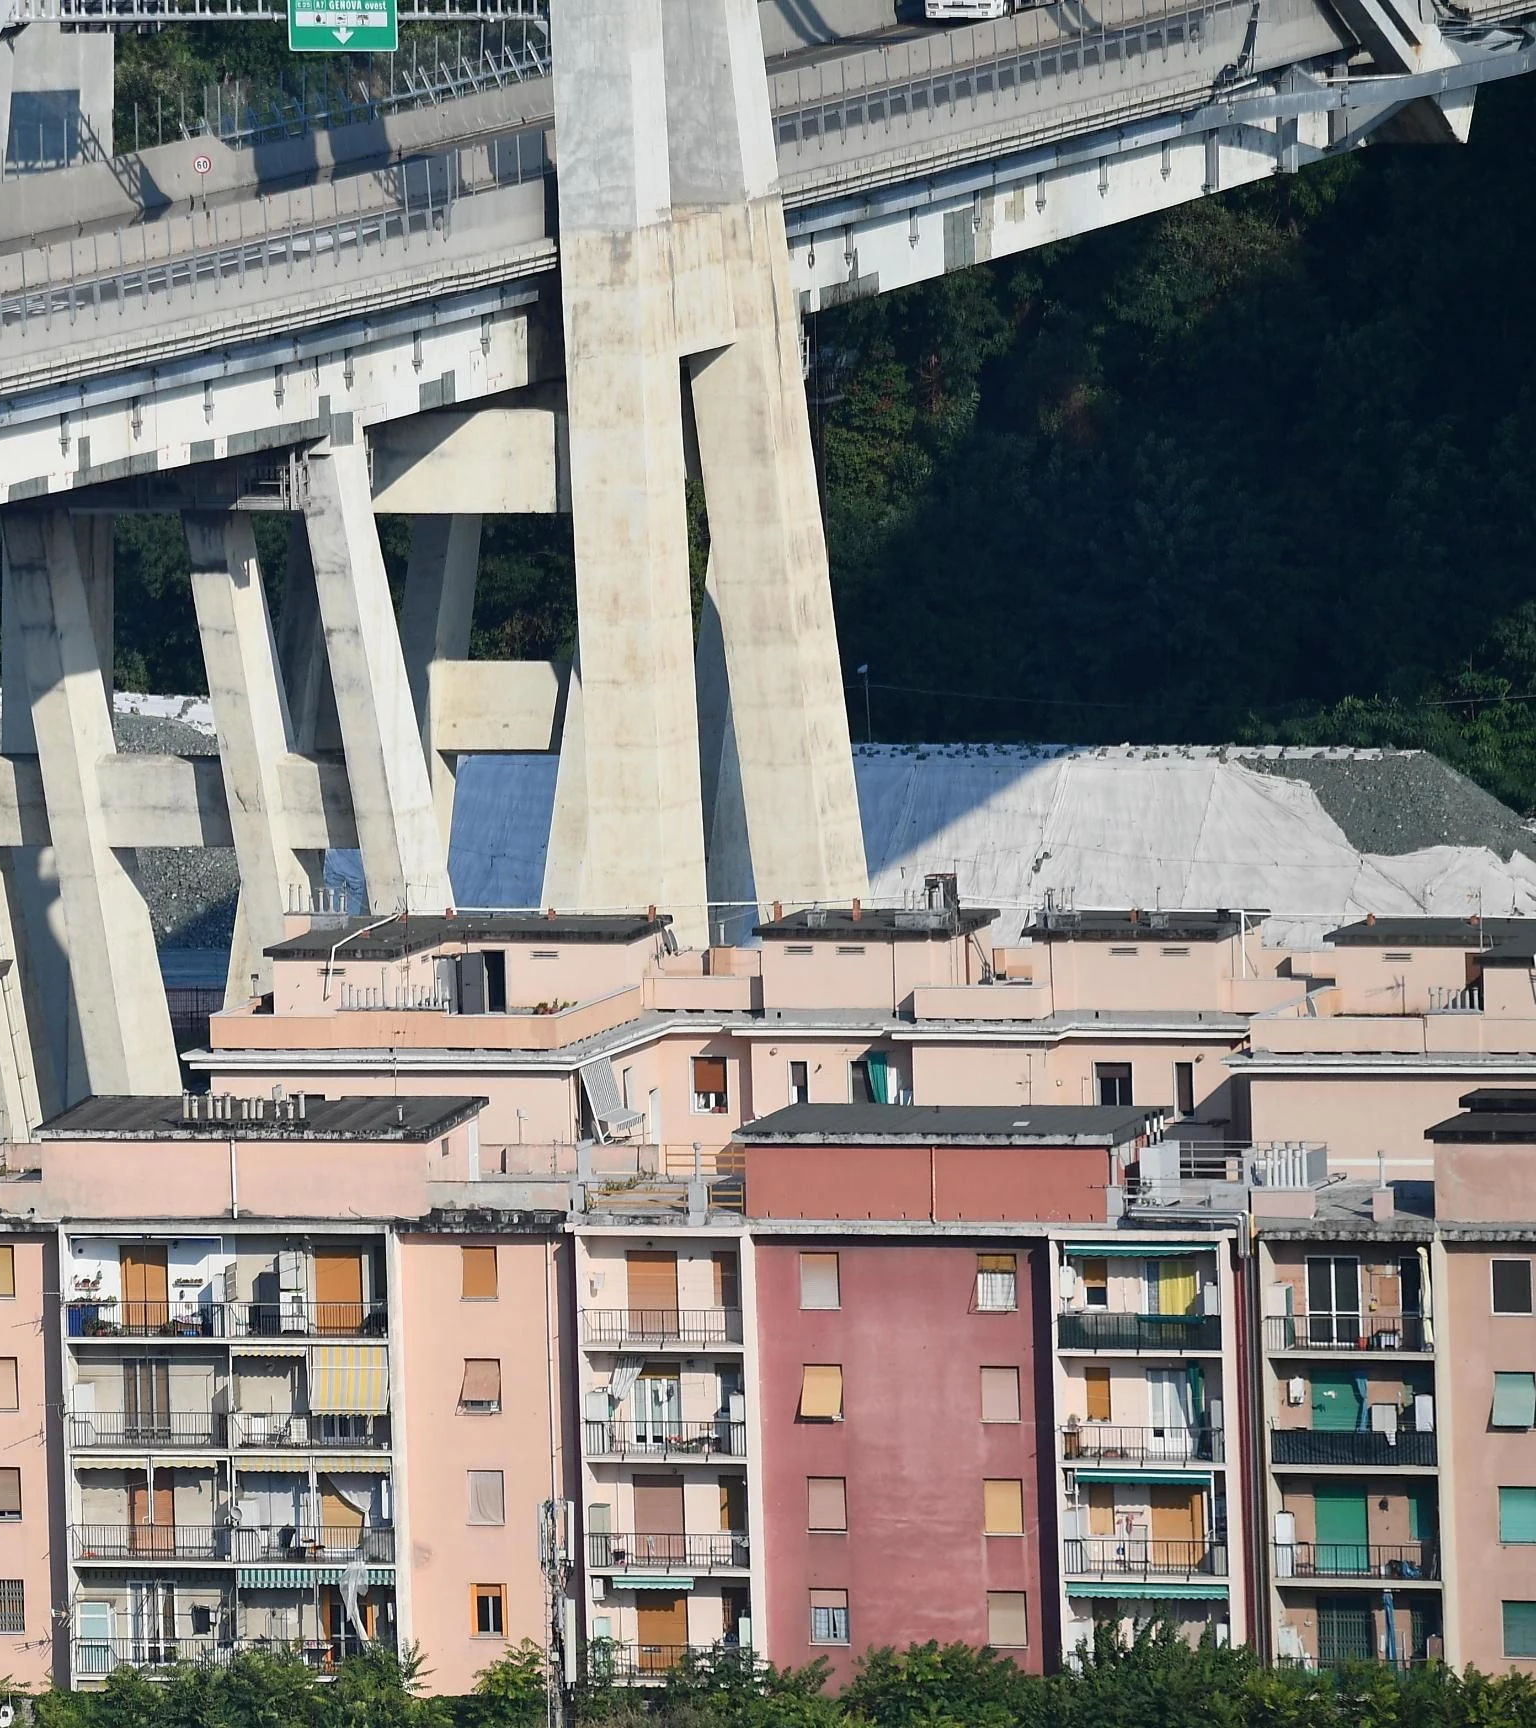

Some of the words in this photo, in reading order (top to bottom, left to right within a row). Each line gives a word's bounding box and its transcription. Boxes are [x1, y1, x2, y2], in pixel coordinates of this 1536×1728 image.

[329, 1, 362, 10] GENOVA
[365, 1, 387, 10] ovest
[197, 160, 208, 169] 60
